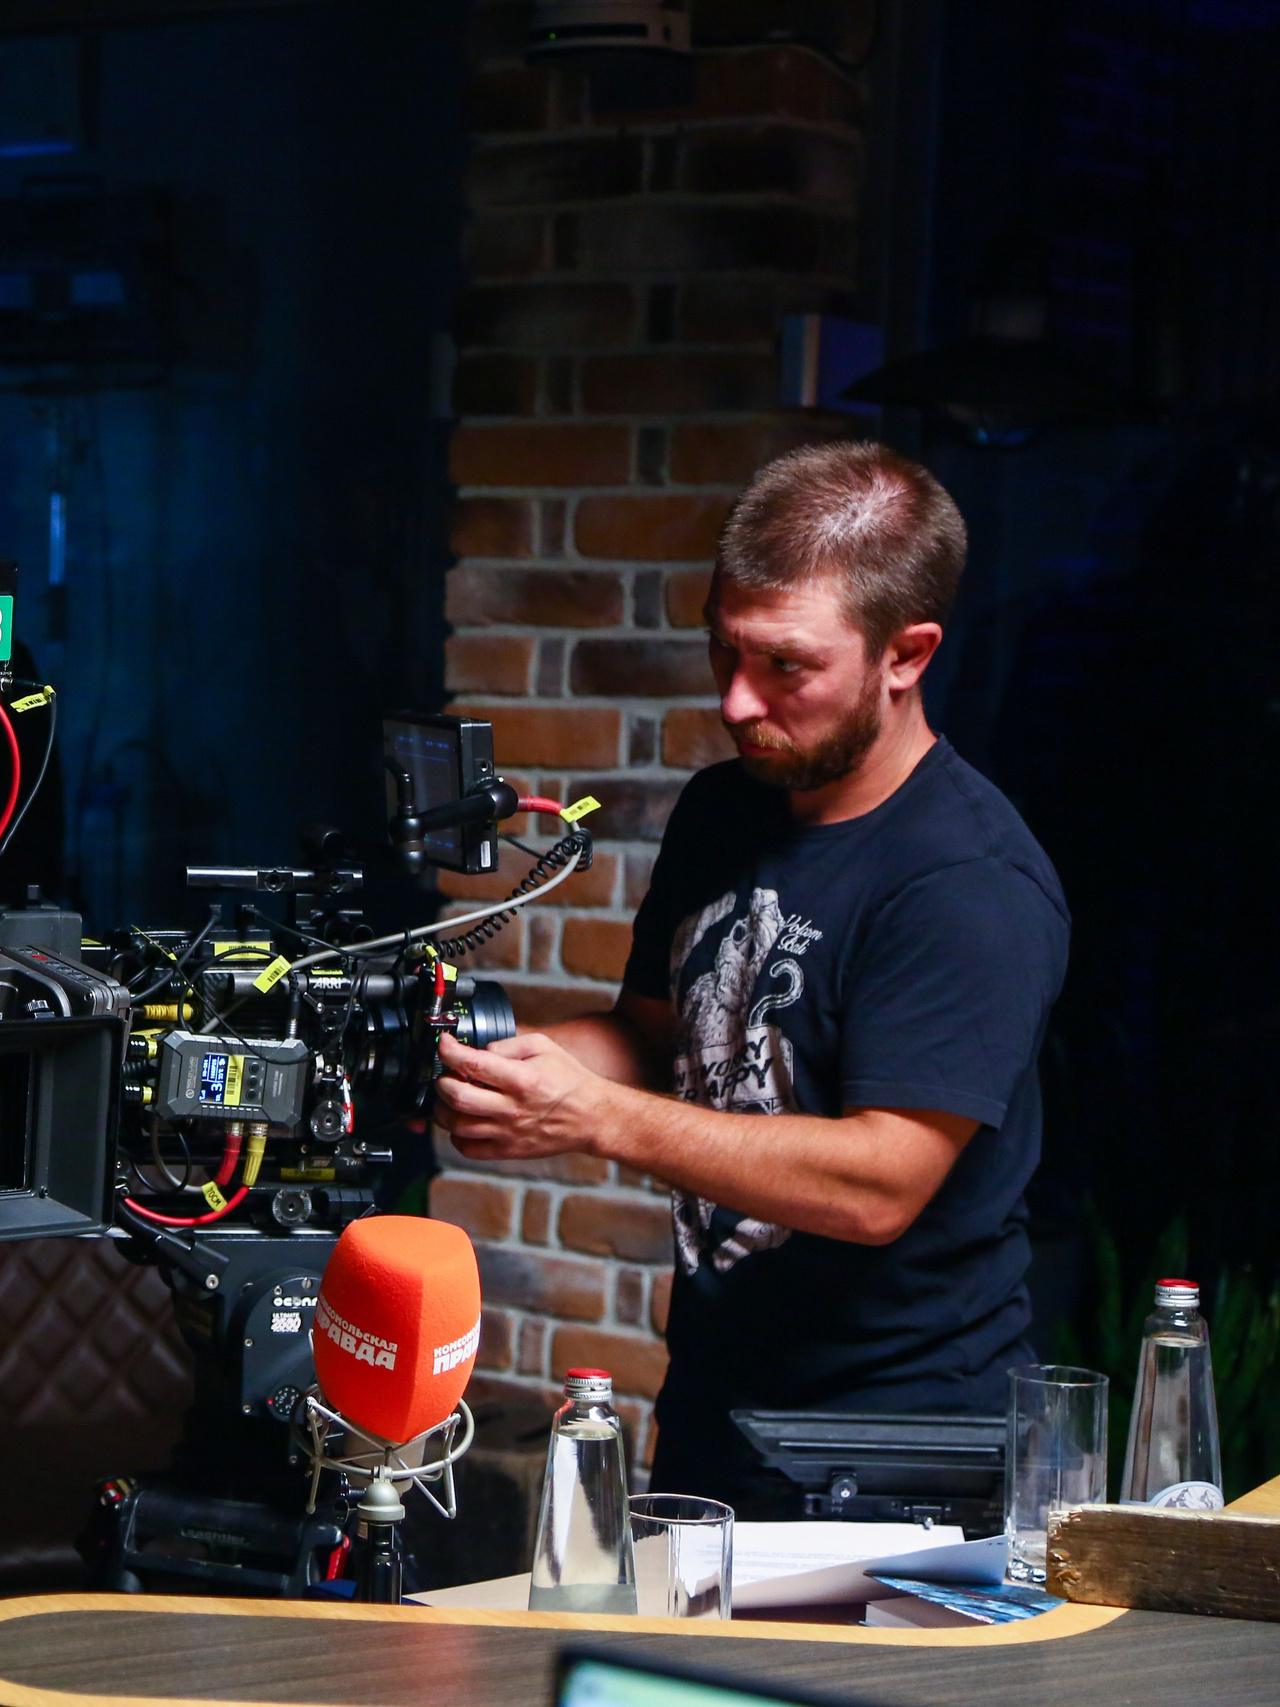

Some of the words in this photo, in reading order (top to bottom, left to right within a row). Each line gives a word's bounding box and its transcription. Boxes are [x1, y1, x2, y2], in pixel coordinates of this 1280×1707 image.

[784, 914, 823, 941] Volcom
[777, 933, 810, 956] Bali
[313, 977, 343, 990] ARRI
[210, 1082, 223, 1092] 3
